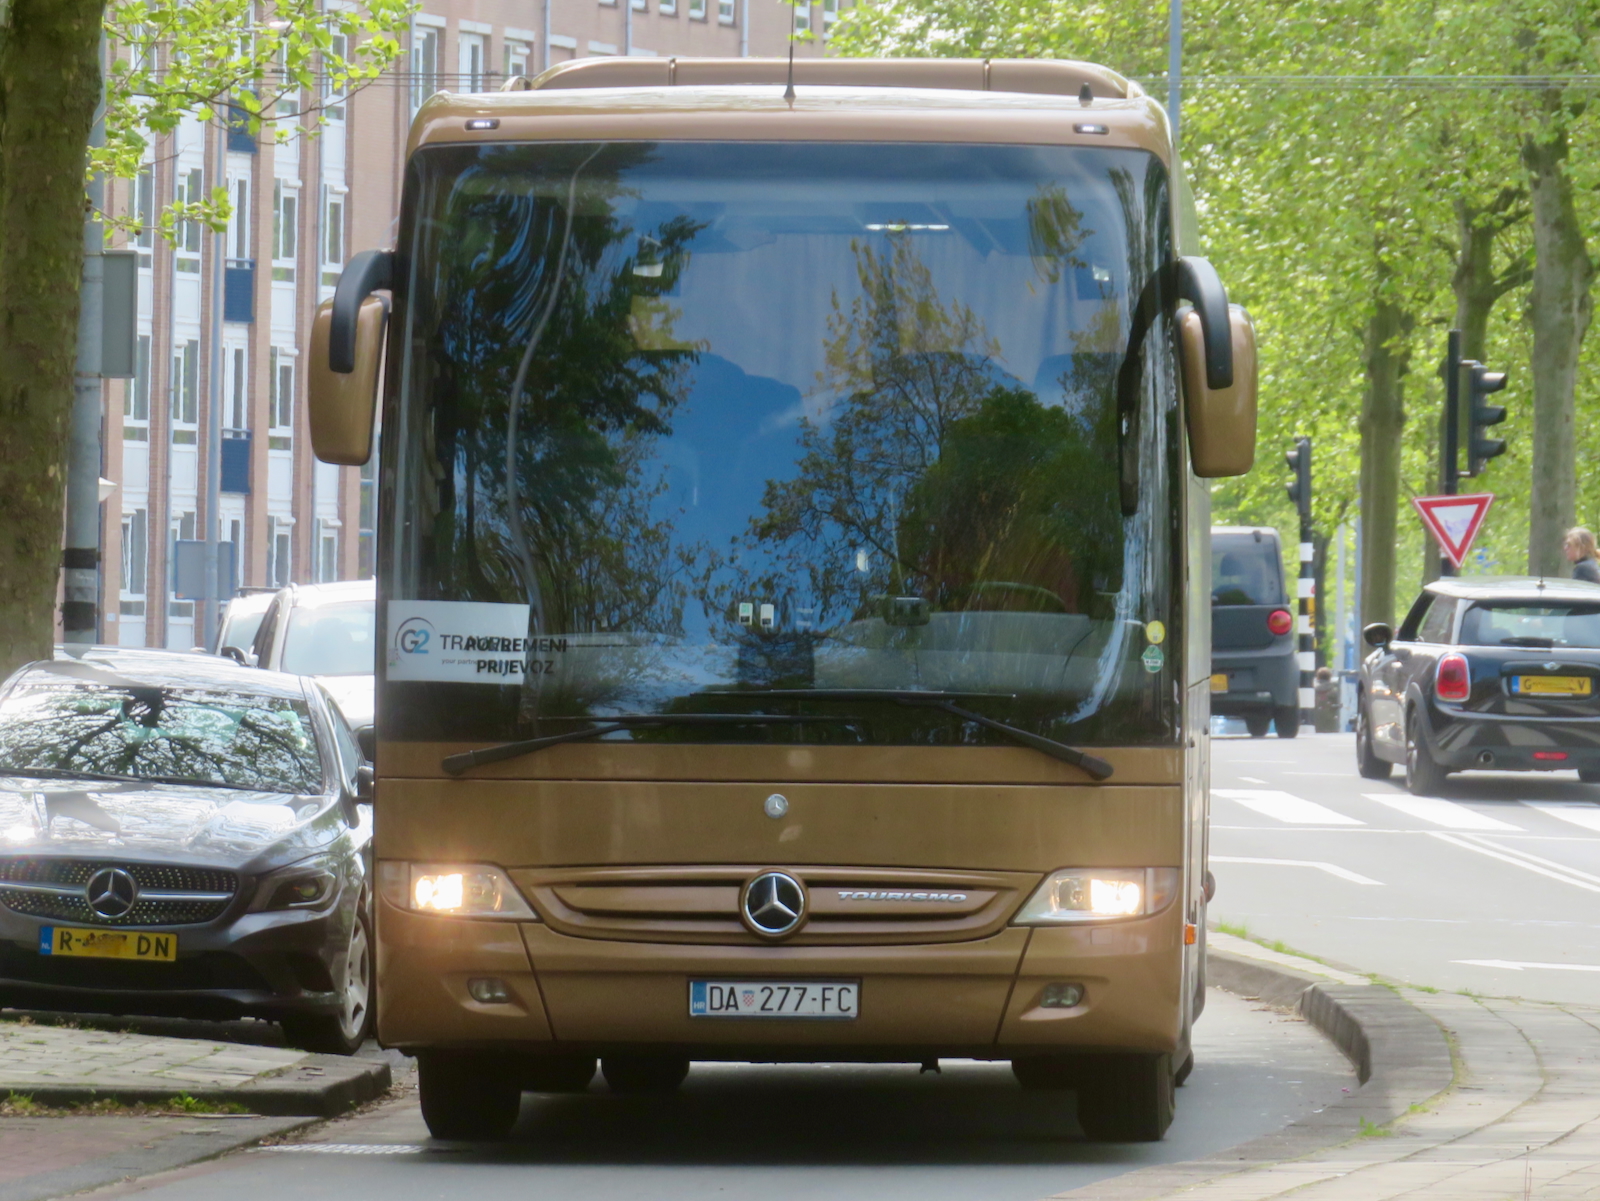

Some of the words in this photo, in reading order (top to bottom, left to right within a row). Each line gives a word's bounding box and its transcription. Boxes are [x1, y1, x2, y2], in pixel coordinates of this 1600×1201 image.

[400, 629, 430, 654] G2
[476, 659, 554, 676] PRIJEVOZ
[838, 891, 967, 903] TOURISMO
[693, 1001, 706, 1010] HR
[709, 986, 739, 1011] DA
[760, 986, 852, 1012] 277-FC
